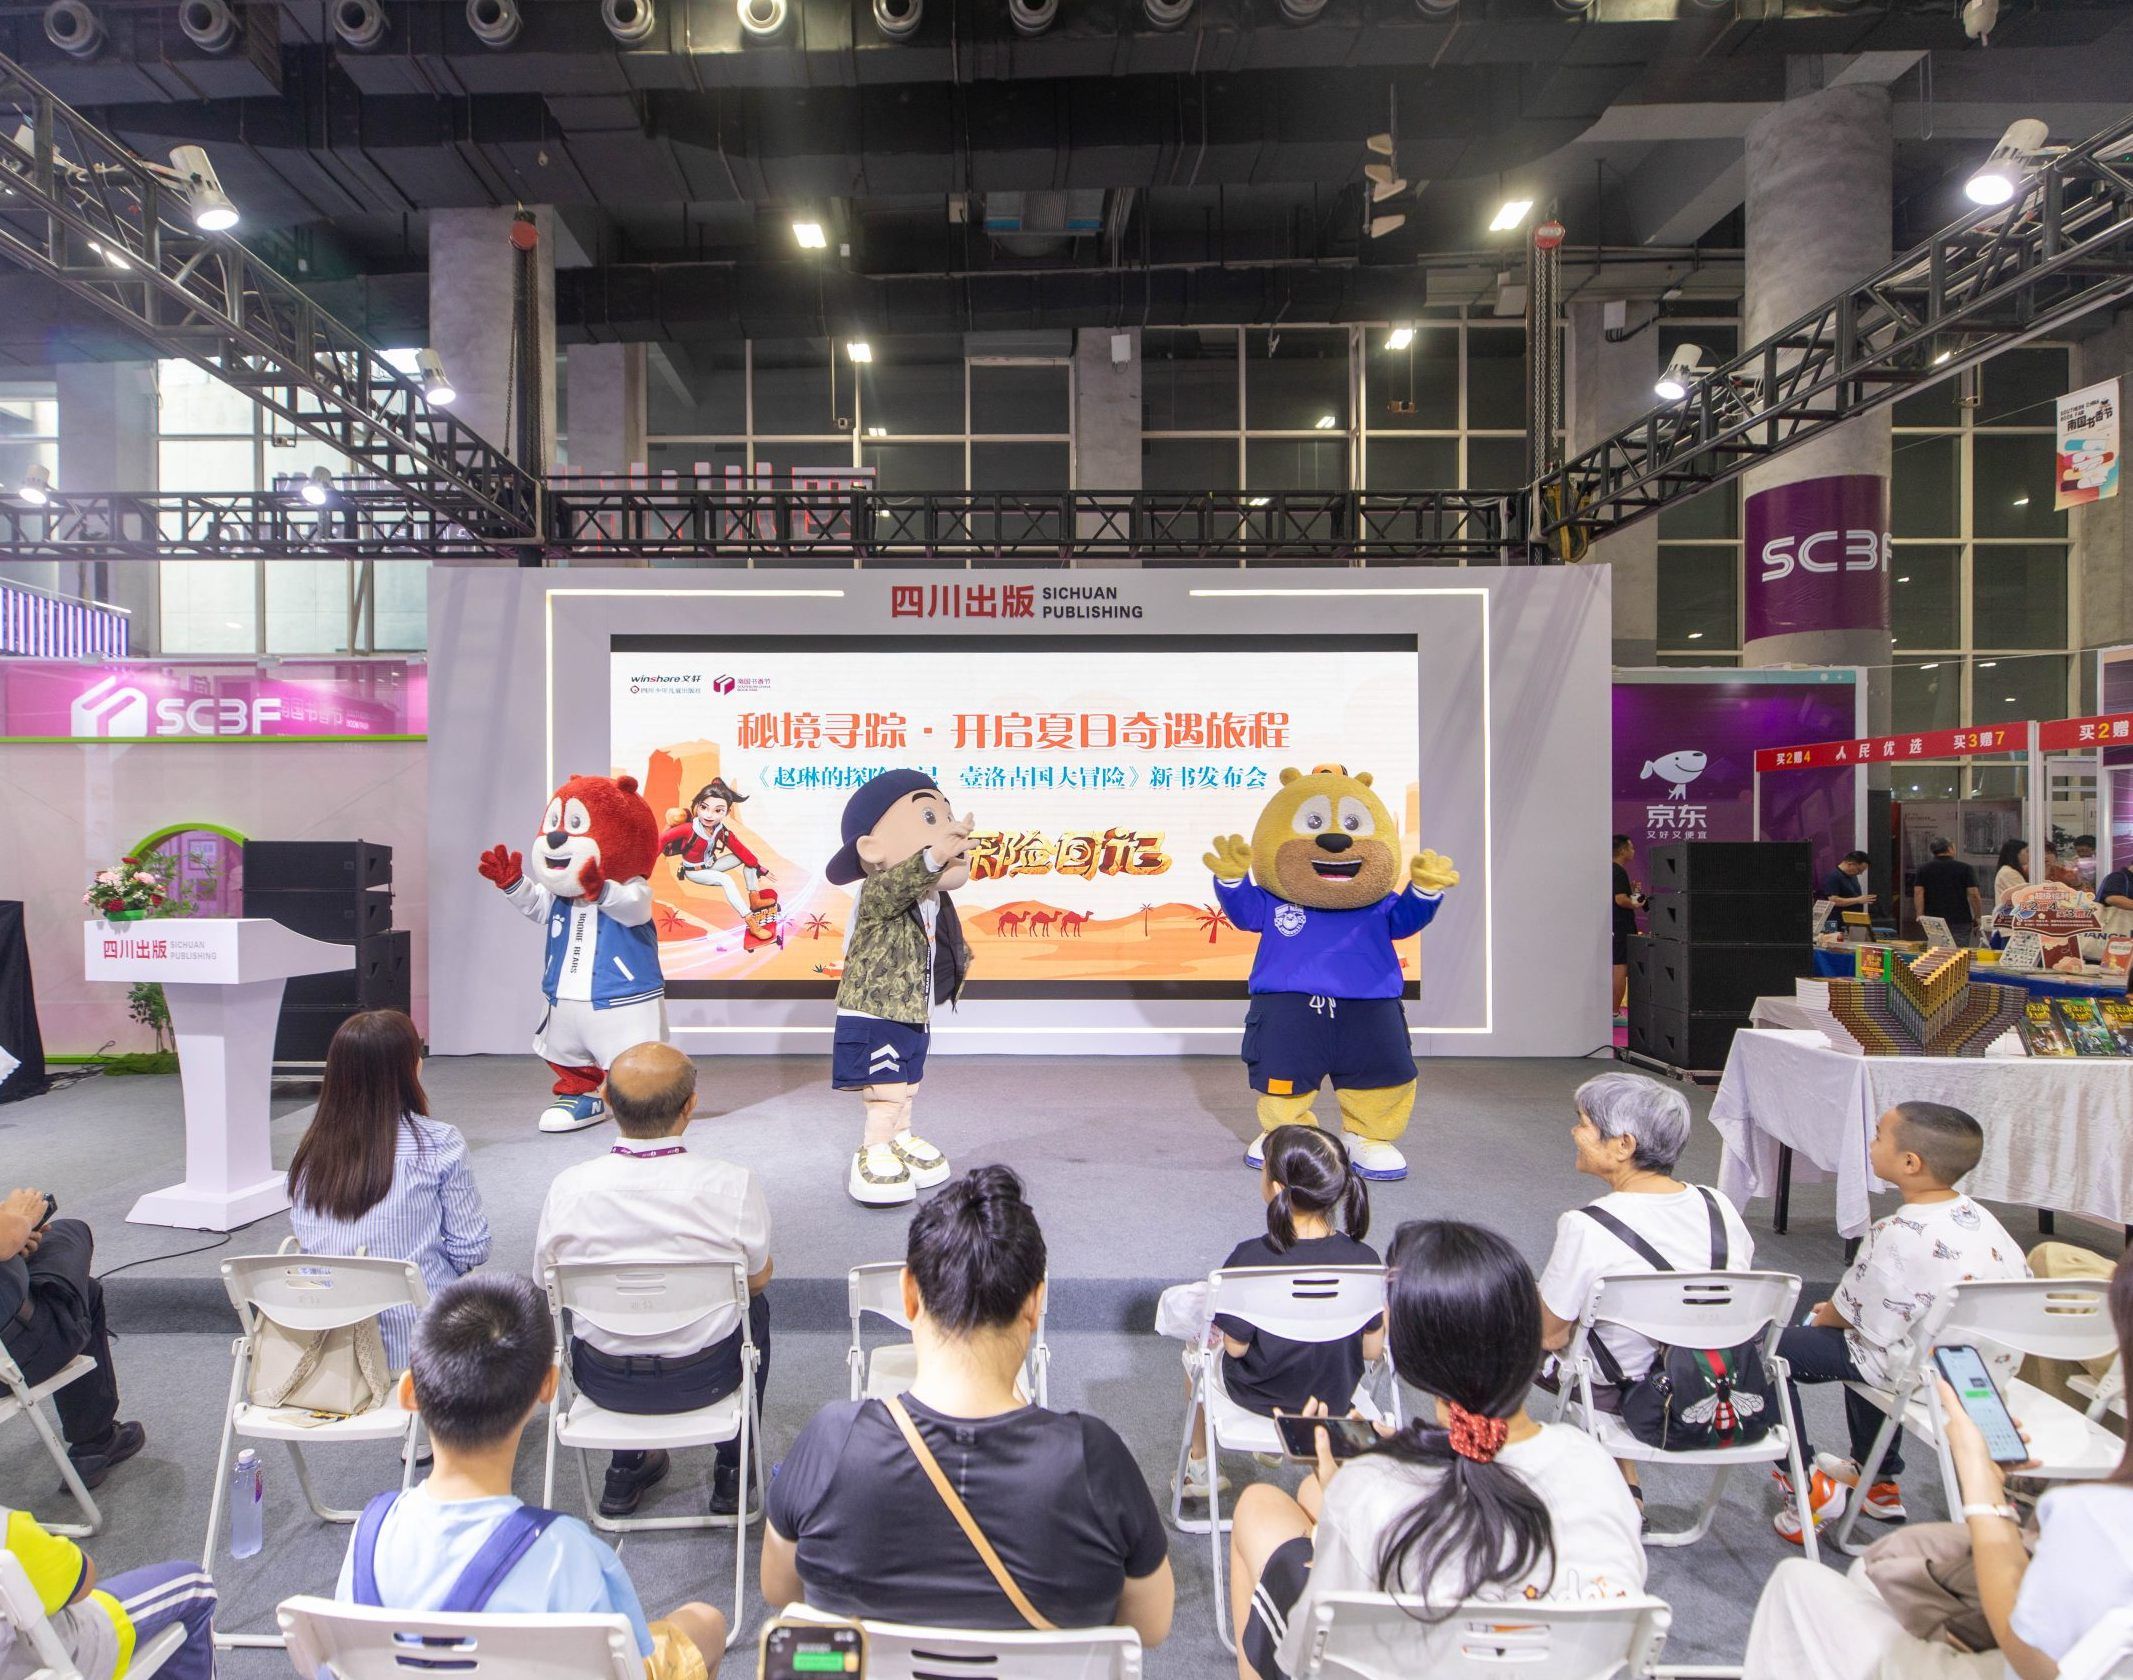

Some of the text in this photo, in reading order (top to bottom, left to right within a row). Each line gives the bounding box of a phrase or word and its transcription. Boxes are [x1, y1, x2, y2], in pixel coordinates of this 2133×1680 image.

[2067, 407, 2113, 432] 南国书香节
[891, 585, 1035, 618] 四川出版
[1042, 586, 1118, 600] SICHUAN
[1042, 605, 1143, 619] PUBLISHING
[631, 675, 702, 683] winshare 文轩
[2080, 720, 2130, 742] 买2赠
[1776, 731, 2005, 766] 买2赠4 人民优选 买3赠7
[1646, 804, 1707, 828] 京东
[1646, 830, 1708, 840] 又好又便宜
[575, 912, 587, 944] BOONIE
[103, 939, 168, 960] 四川出版
[169, 940, 205, 949] SICHUAN
[169, 951, 217, 960] PUBLISHING
